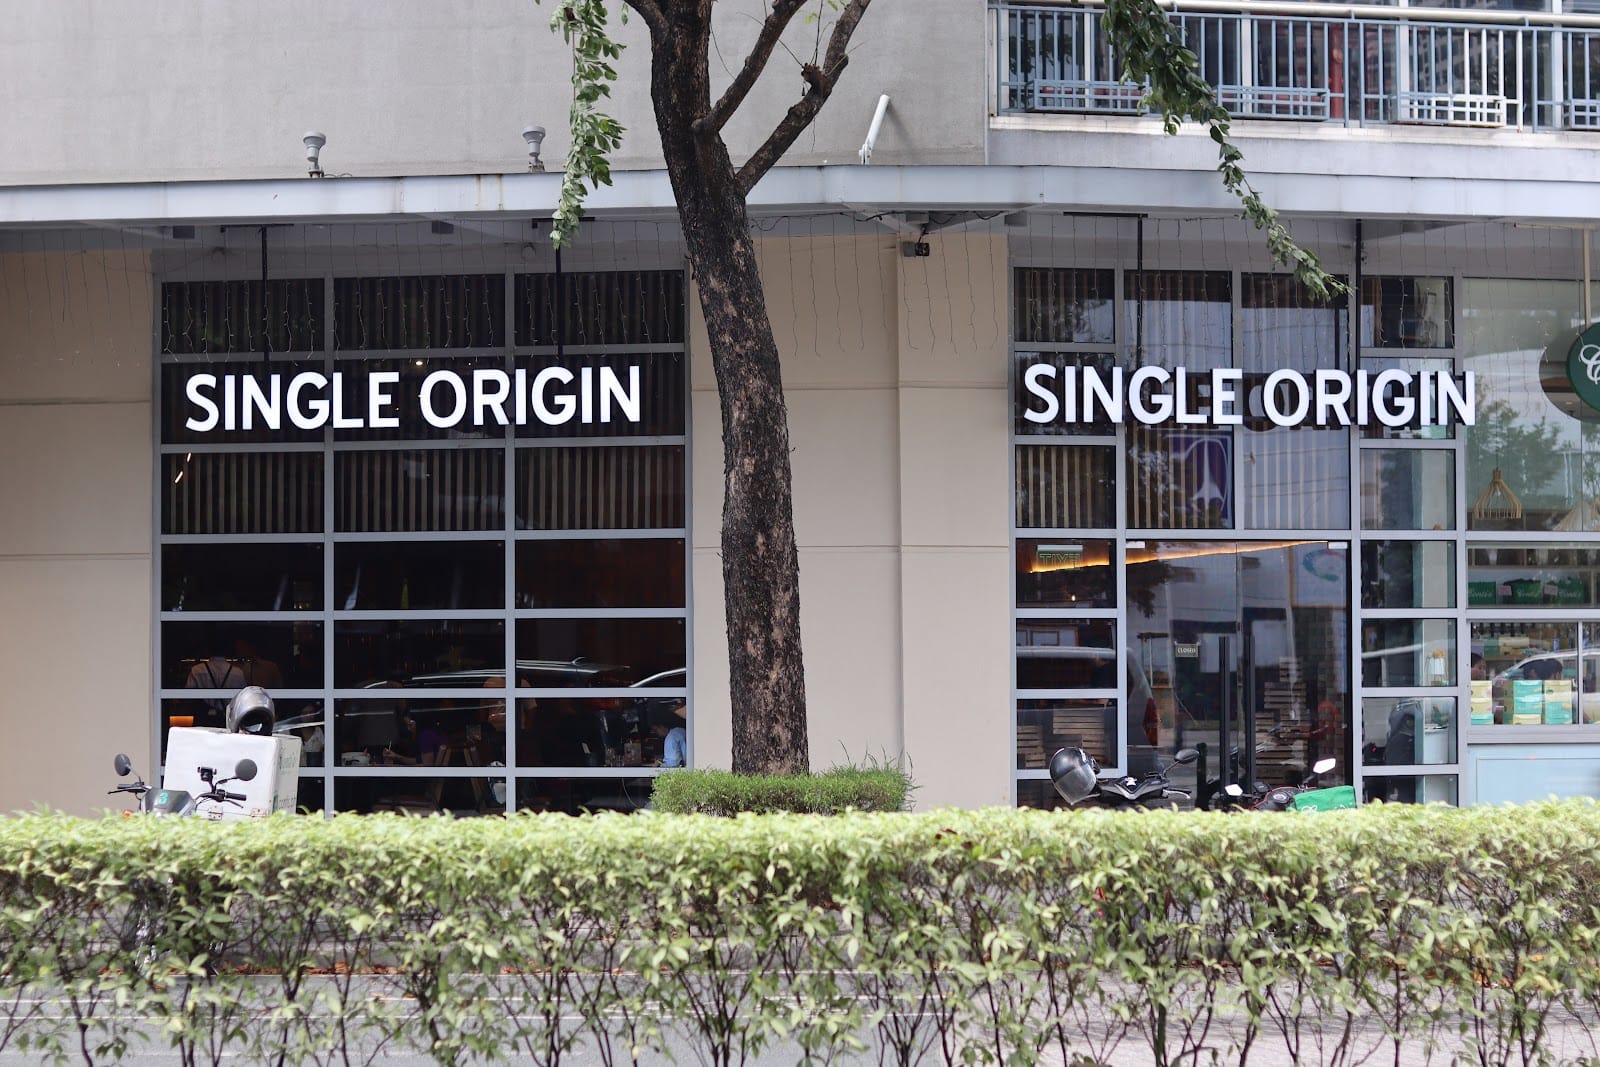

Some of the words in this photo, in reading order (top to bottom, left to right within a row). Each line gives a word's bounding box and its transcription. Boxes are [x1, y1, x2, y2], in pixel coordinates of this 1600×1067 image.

[185, 371, 400, 433] SINGLE
[419, 365, 641, 429] ORIGIN
[1023, 363, 1244, 425] SINGLE
[1262, 367, 1477, 427] ORIGIN
[158, 791, 170, 805] 3
